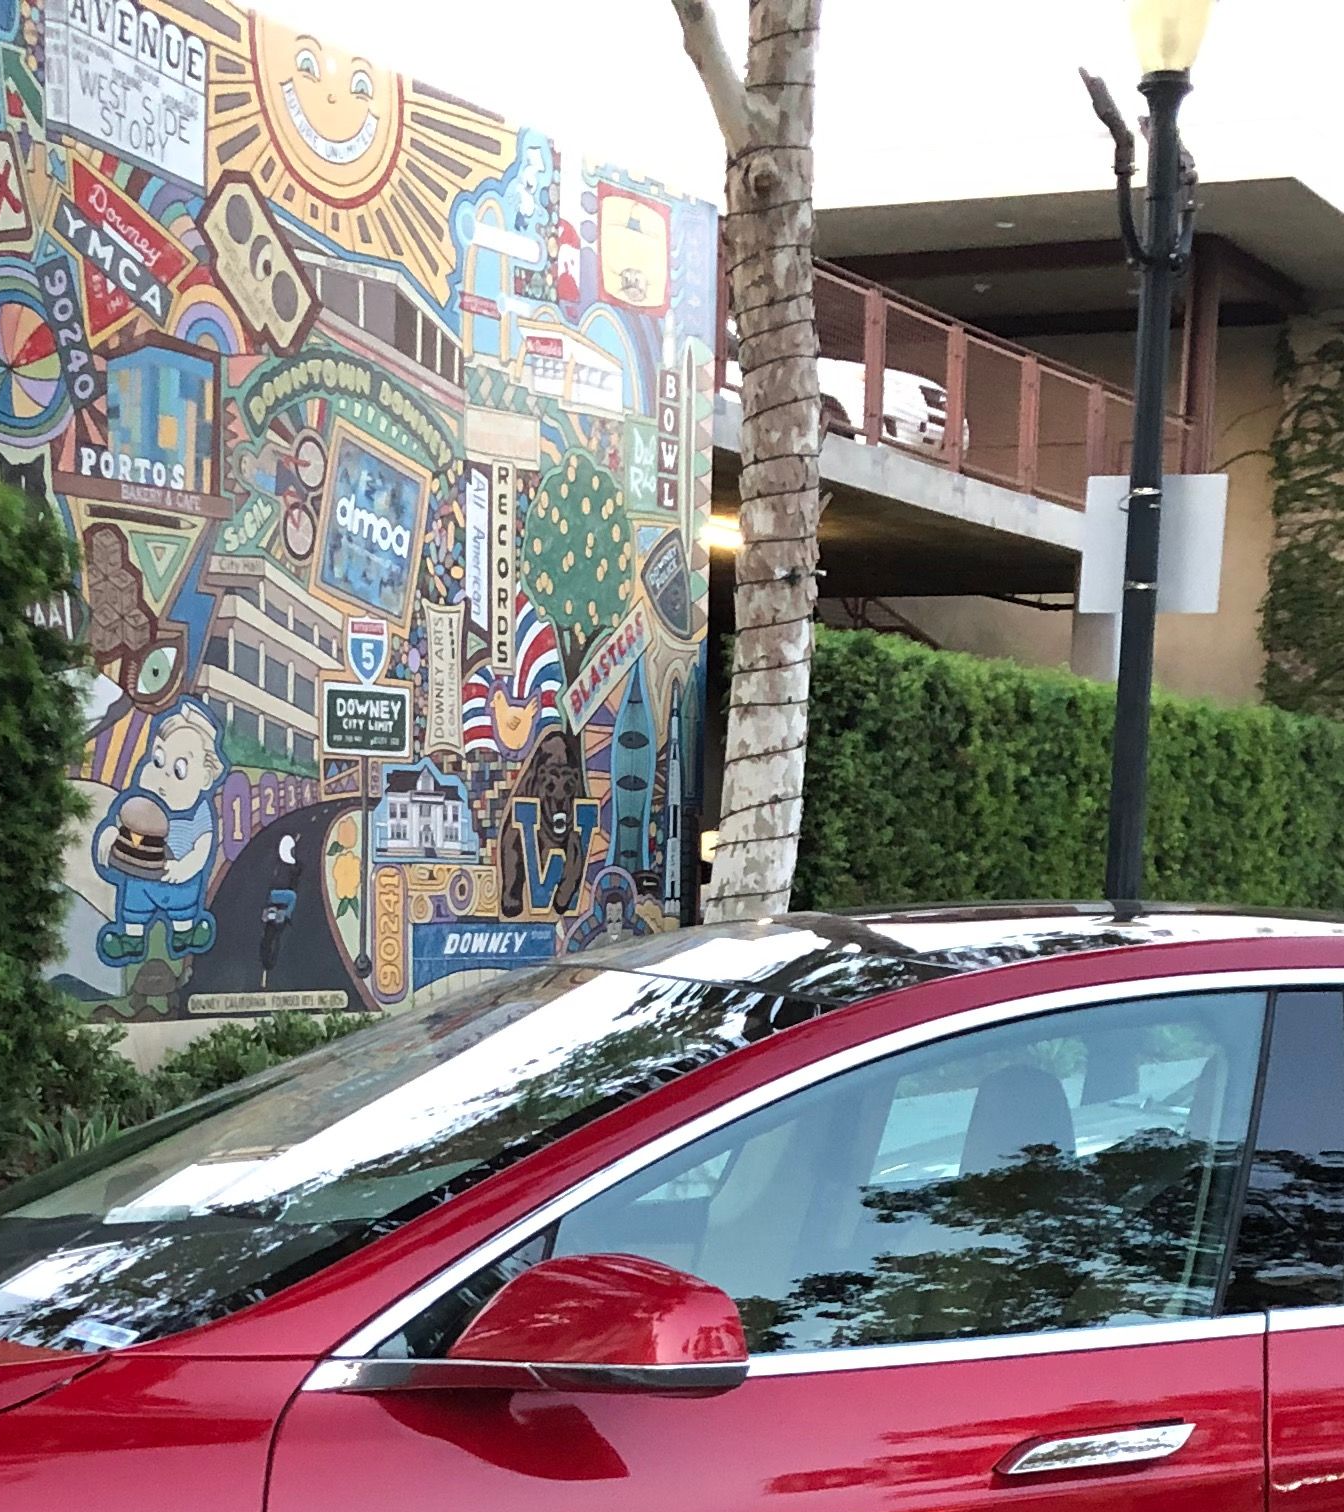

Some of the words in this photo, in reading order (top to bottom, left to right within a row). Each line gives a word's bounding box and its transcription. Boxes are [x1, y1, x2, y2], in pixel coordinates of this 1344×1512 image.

[78, 64, 131, 112] WEST
[142, 96, 191, 145] SIDE
[100, 105, 169, 162] STORY
[89, 183, 162, 267] Downey
[63, 204, 163, 317] YMCA
[43, 269, 95, 400] 90240
[250, 358, 372, 425] DOWNTOWN
[379, 380, 453, 467] DOWNEY
[660, 374, 678, 507] BOWL
[337, 494, 411, 559] dmoa
[497, 466, 510, 663] RECORDS
[361, 642, 375, 670] 5
[433, 617, 445, 661] ARTS
[336, 697, 402, 721] DOWNEY
[342, 718, 365, 730] CITY
[368, 720, 394, 733] LIMIT
[434, 667, 446, 739] DOWNEY
[232, 796, 243, 841] 1
[264, 787, 275, 815] 2
[380, 873, 401, 987] 90241
[444, 932, 527, 955] DOWNEY
